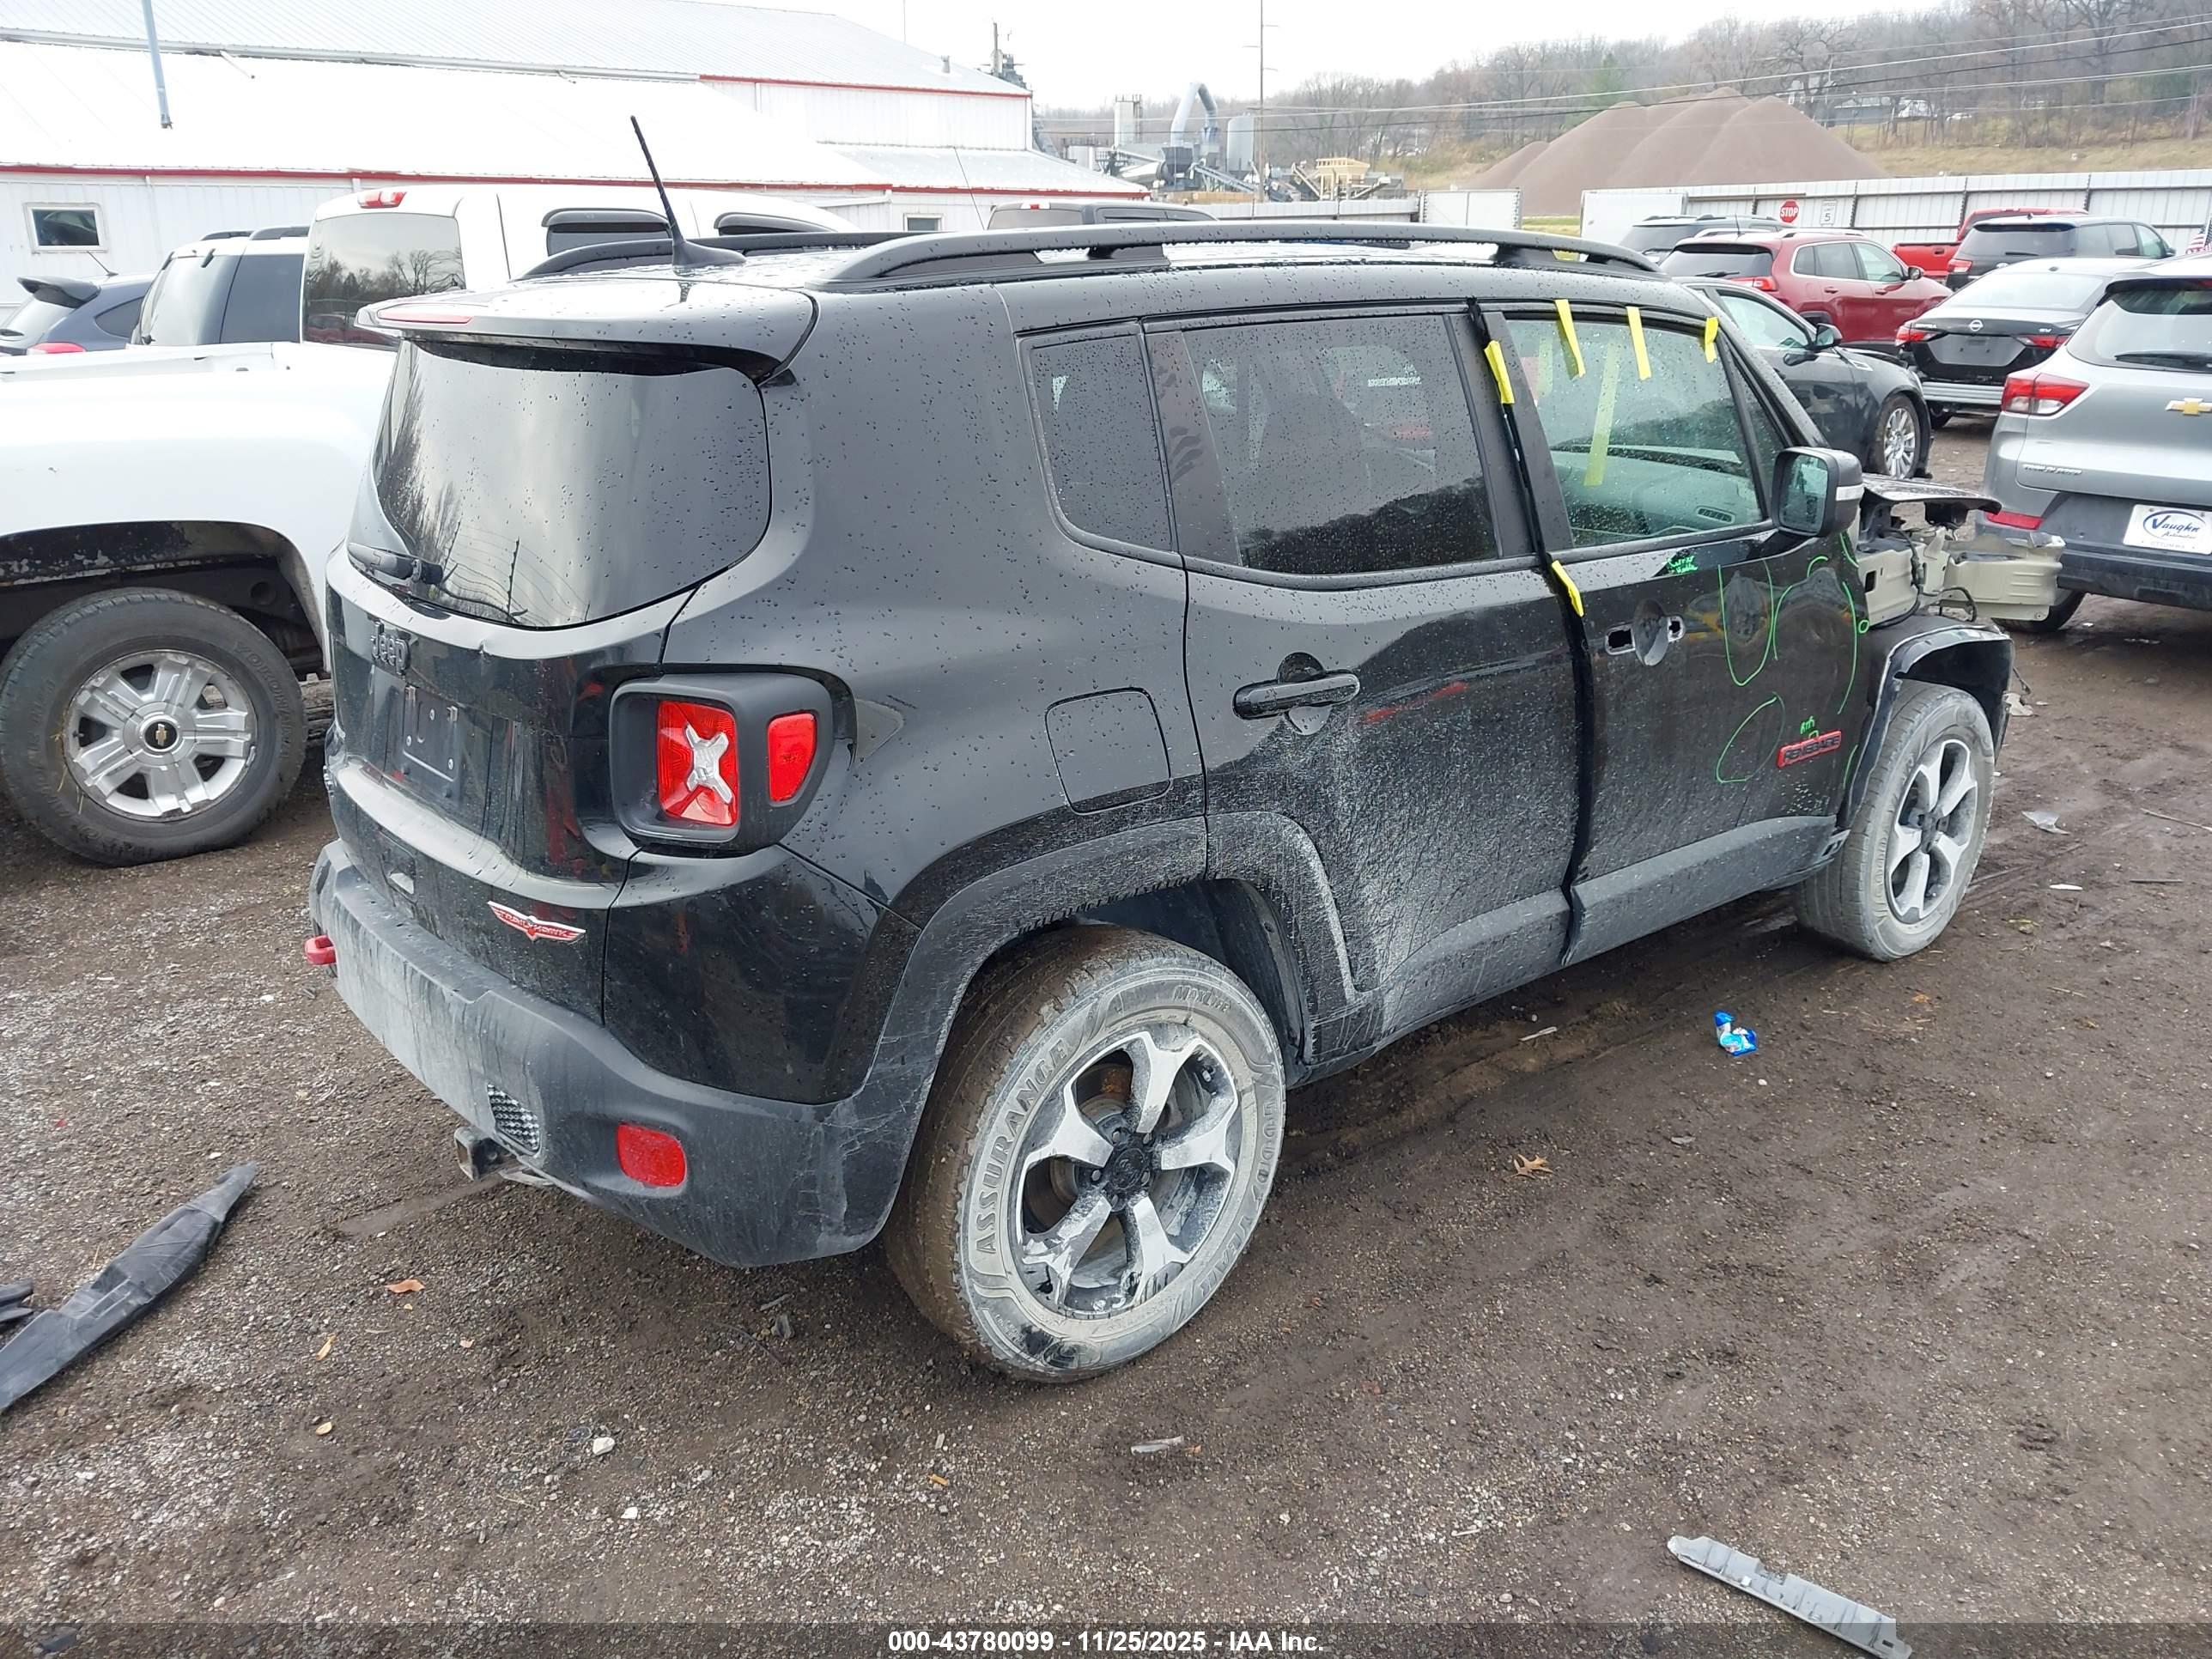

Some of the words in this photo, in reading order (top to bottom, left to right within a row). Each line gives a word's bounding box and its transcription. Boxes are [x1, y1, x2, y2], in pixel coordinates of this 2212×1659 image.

[1780, 207, 1798, 217] STOP
[1825, 212, 1831, 222] 5
[2152, 515, 2200, 533] Vaughn
[369, 619, 411, 676] Jeep
[1784, 736, 1841, 761] RENEGADE
[975, 1038, 1069, 1255] ASSURANCE
